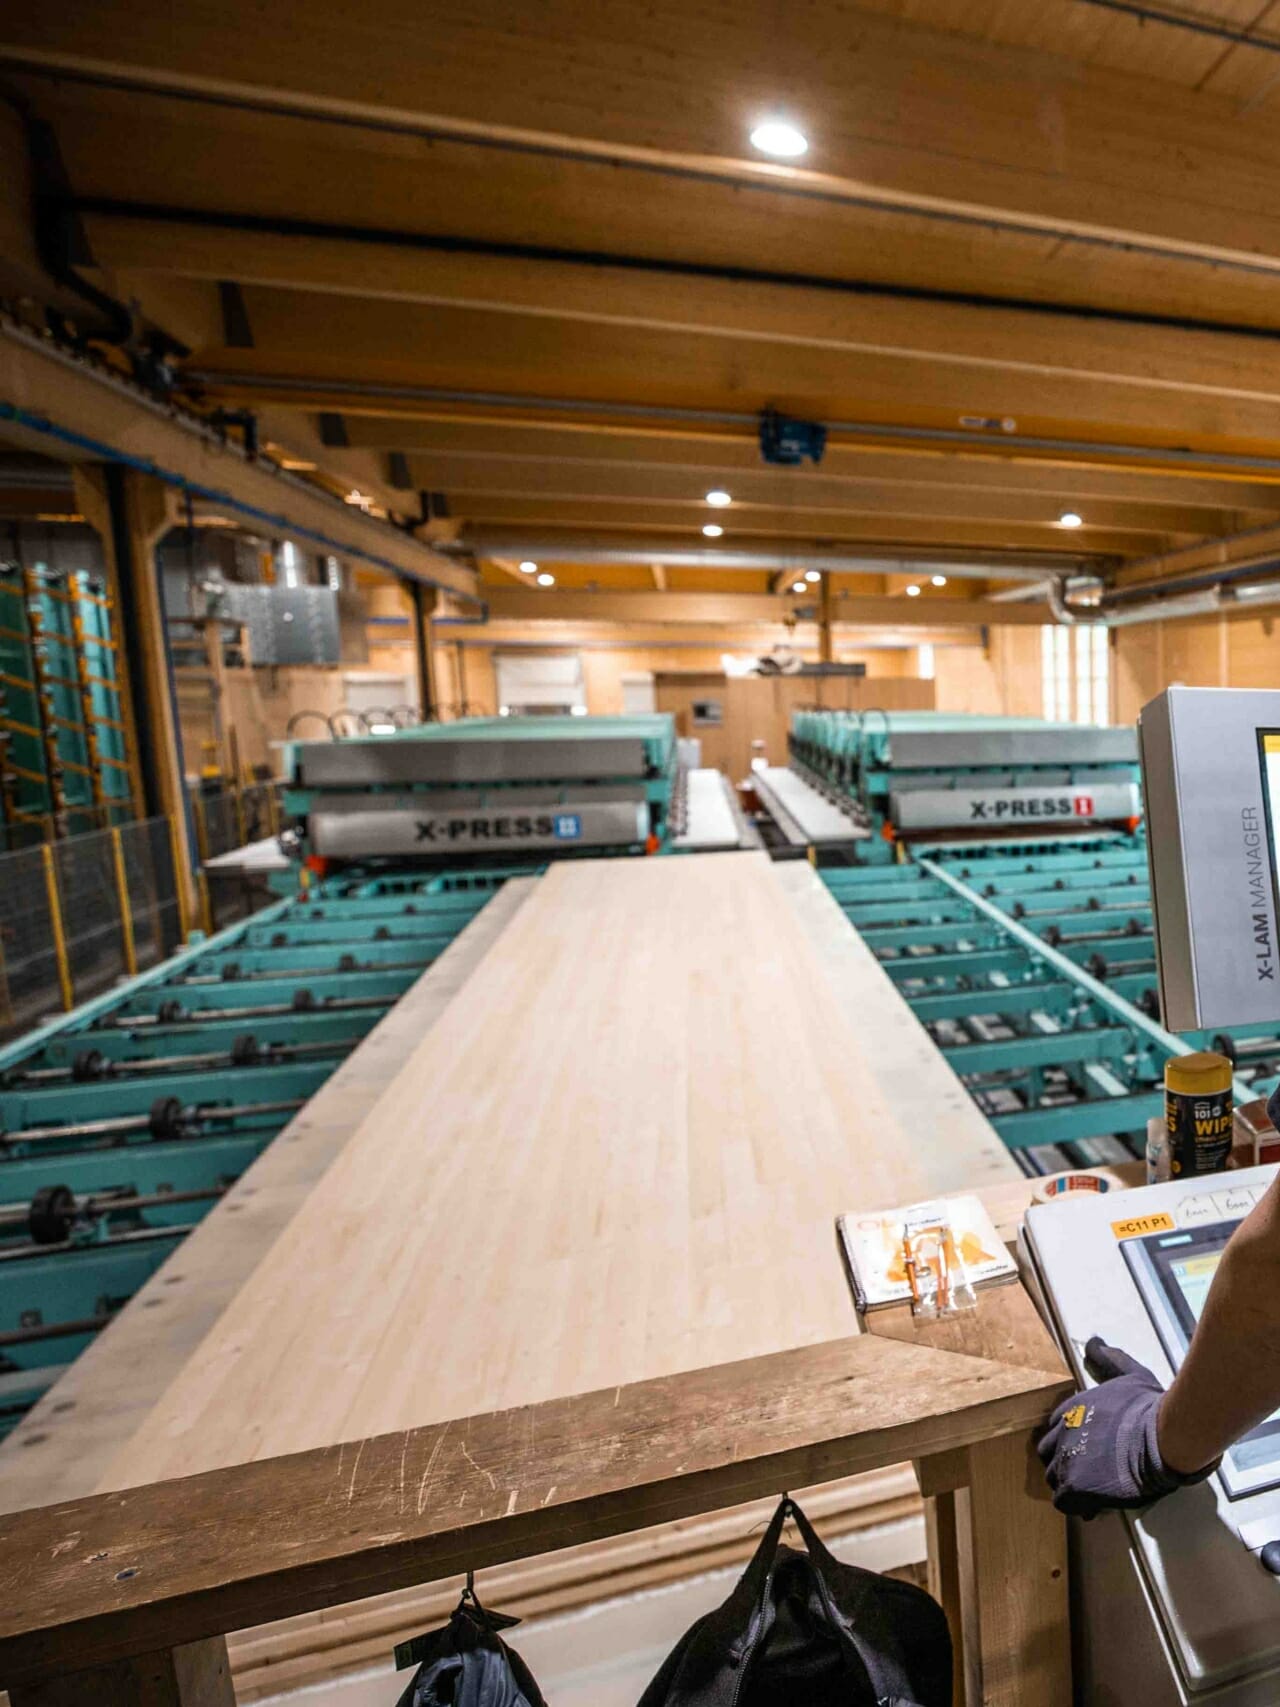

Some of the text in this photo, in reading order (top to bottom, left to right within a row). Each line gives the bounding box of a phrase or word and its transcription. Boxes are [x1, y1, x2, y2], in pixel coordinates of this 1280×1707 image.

[971, 798, 1071, 818] X-PRESS
[416, 815, 552, 842] X-PRESS
[1242, 806, 1275, 981] X-LAM MANAGER
[1152, 1216, 1168, 1228] P1
